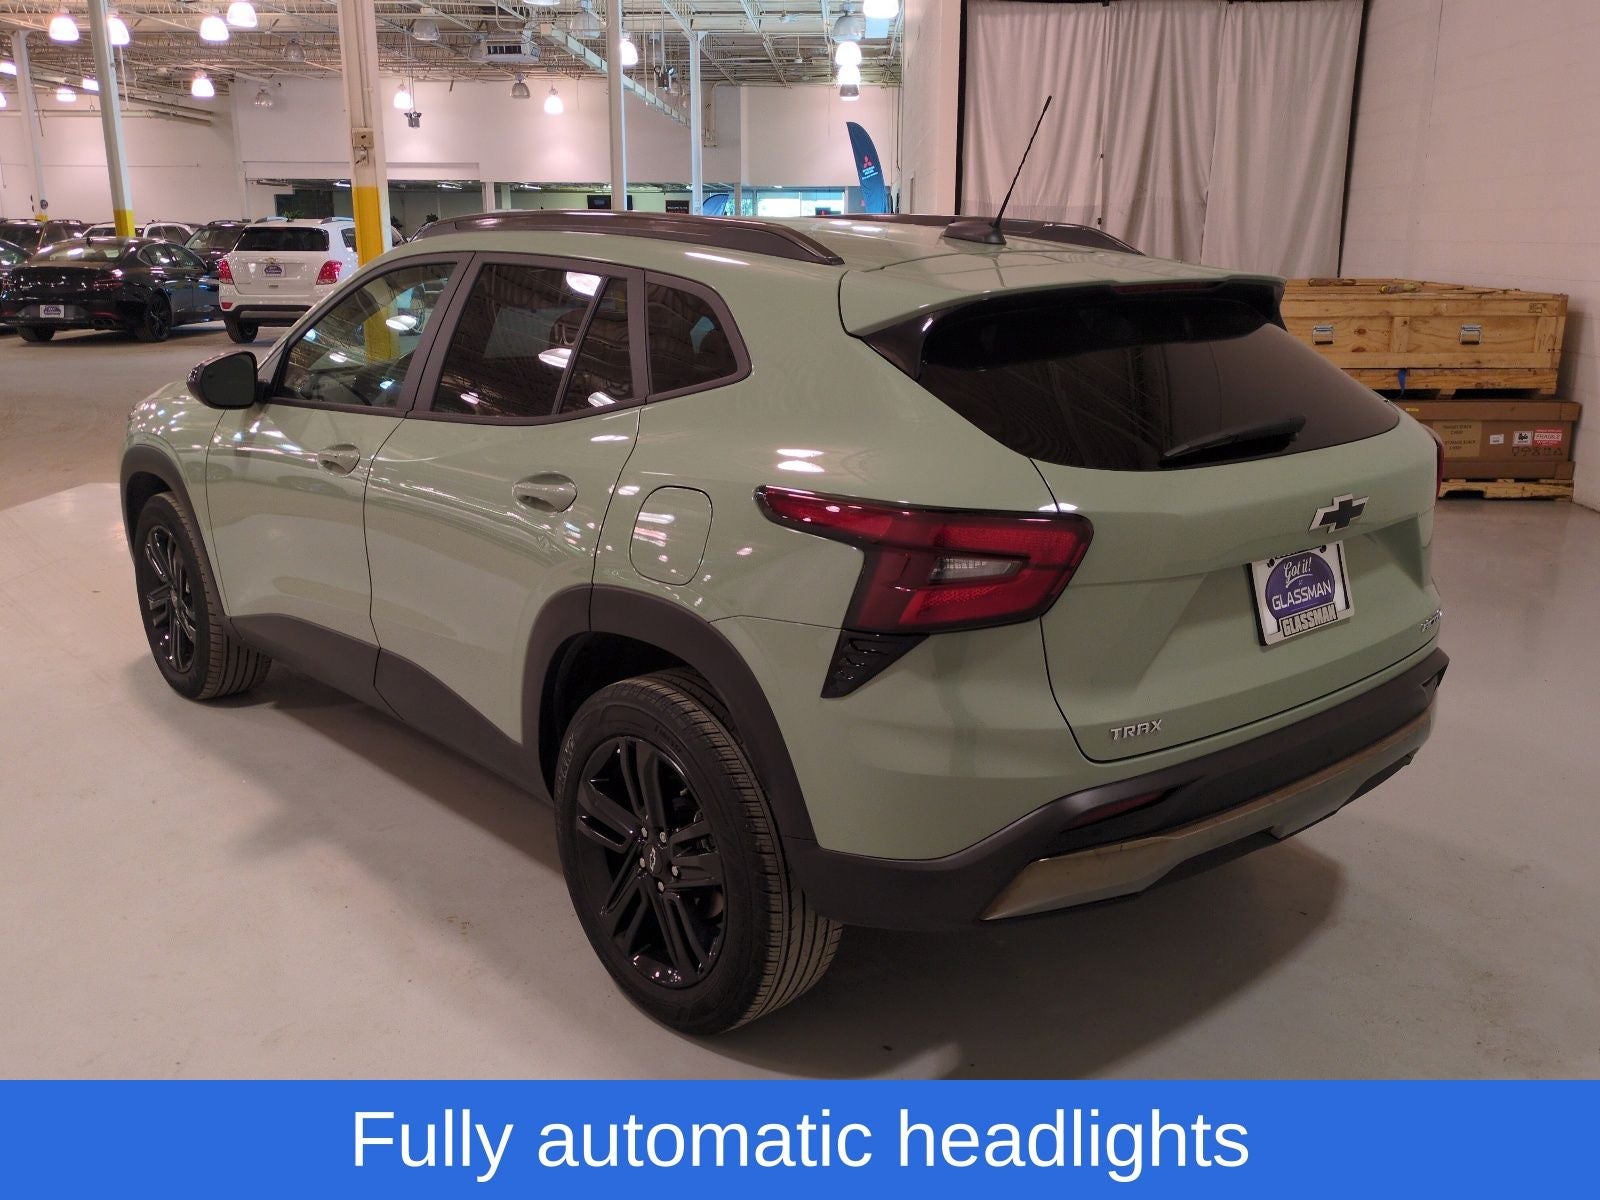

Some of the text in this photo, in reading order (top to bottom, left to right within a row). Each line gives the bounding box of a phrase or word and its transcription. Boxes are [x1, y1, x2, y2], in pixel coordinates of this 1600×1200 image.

[1284, 557, 1312, 584] Got it!
[1272, 579, 1332, 610] GLASSMAN
[1282, 604, 1338, 636] GLASSMAN
[1110, 719, 1162, 740] TRAX
